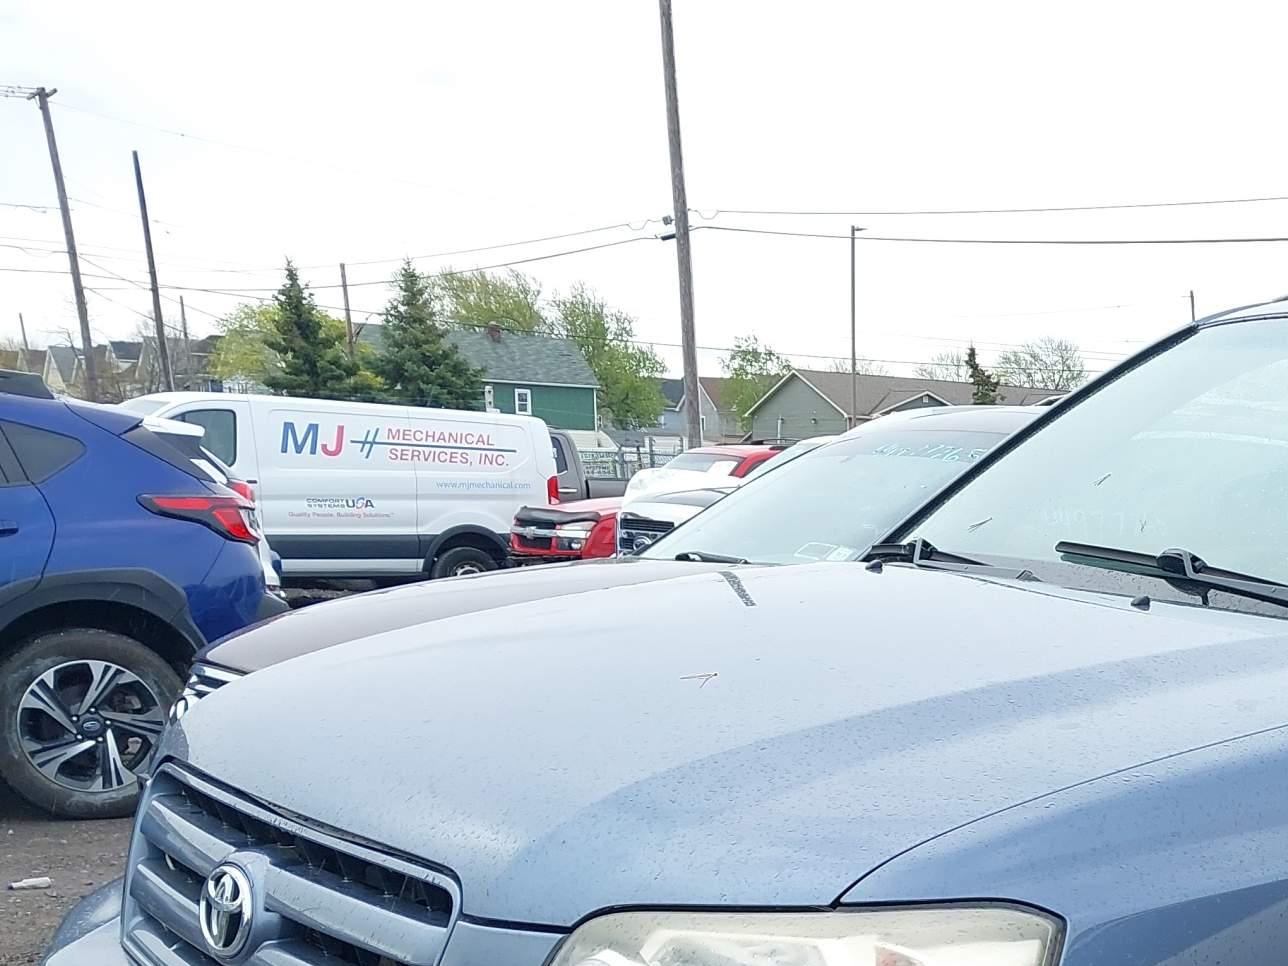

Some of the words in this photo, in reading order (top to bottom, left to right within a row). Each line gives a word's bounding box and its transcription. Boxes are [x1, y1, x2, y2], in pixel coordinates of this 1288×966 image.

[281, 421, 345, 457] MJ
[386, 427, 495, 446] MECHANICAL
[388, 447, 473, 467] SERVICES,
[478, 452, 509, 467] INC.
[435, 480, 531, 491] www.mjmechanical.com
